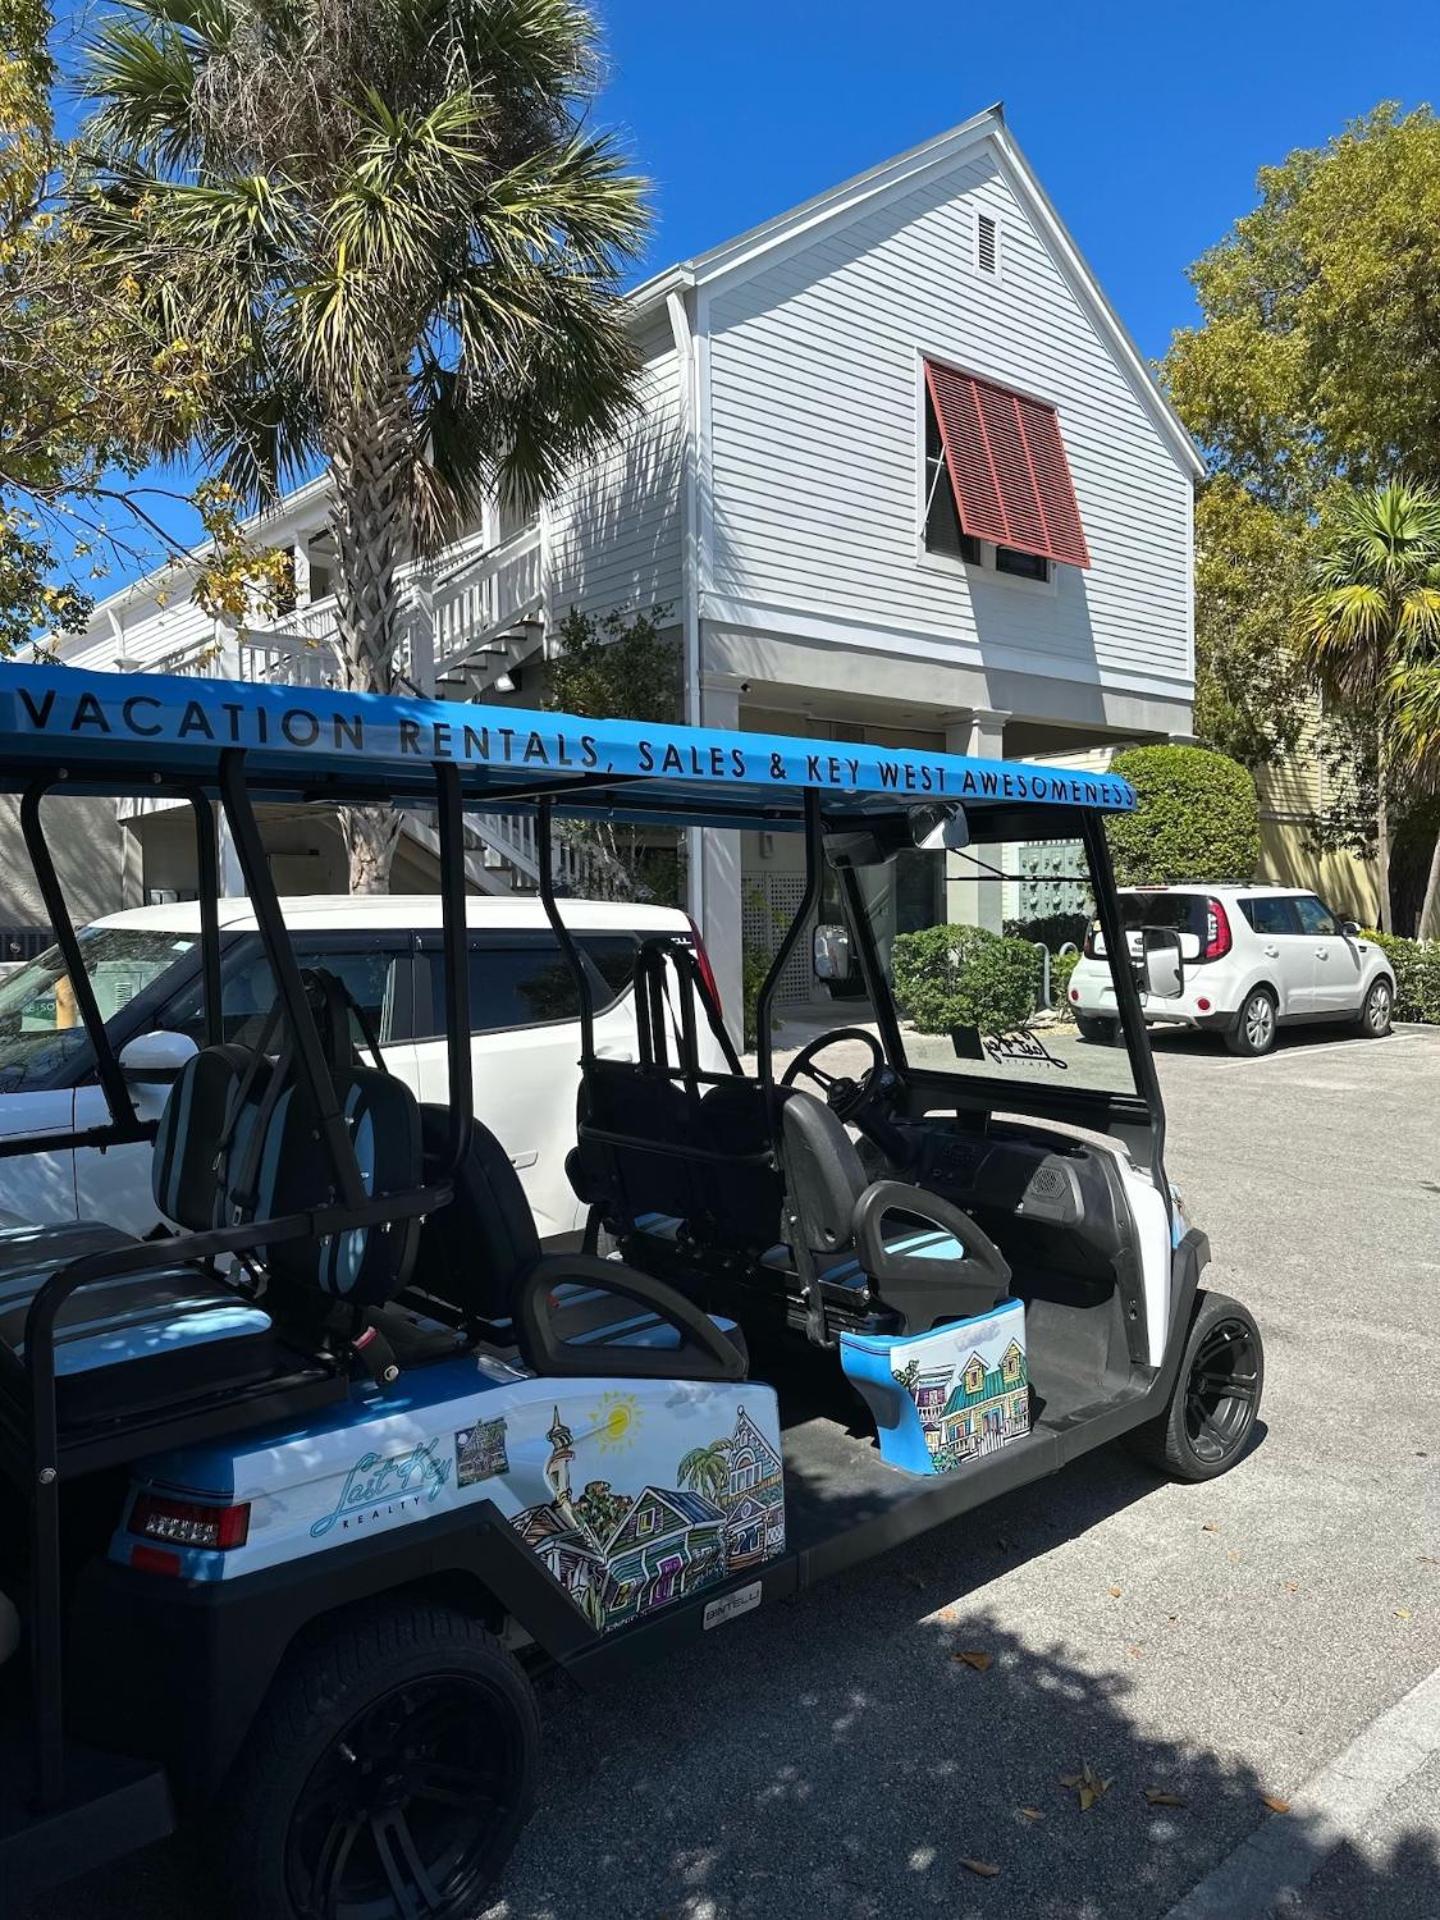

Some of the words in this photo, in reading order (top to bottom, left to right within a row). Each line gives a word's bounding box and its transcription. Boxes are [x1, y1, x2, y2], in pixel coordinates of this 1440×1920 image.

[16, 688, 364, 750] VACATION
[400, 719, 614, 774] RENTALS,
[638, 740, 746, 778] SALES
[769, 752, 787, 780] &
[807, 754, 861, 785] KEY
[878, 761, 946, 791] WEST
[961, 769, 1134, 806] AWESOMENESS
[397, 1436, 453, 1503] Key
[342, 1496, 421, 1529] REALTY
